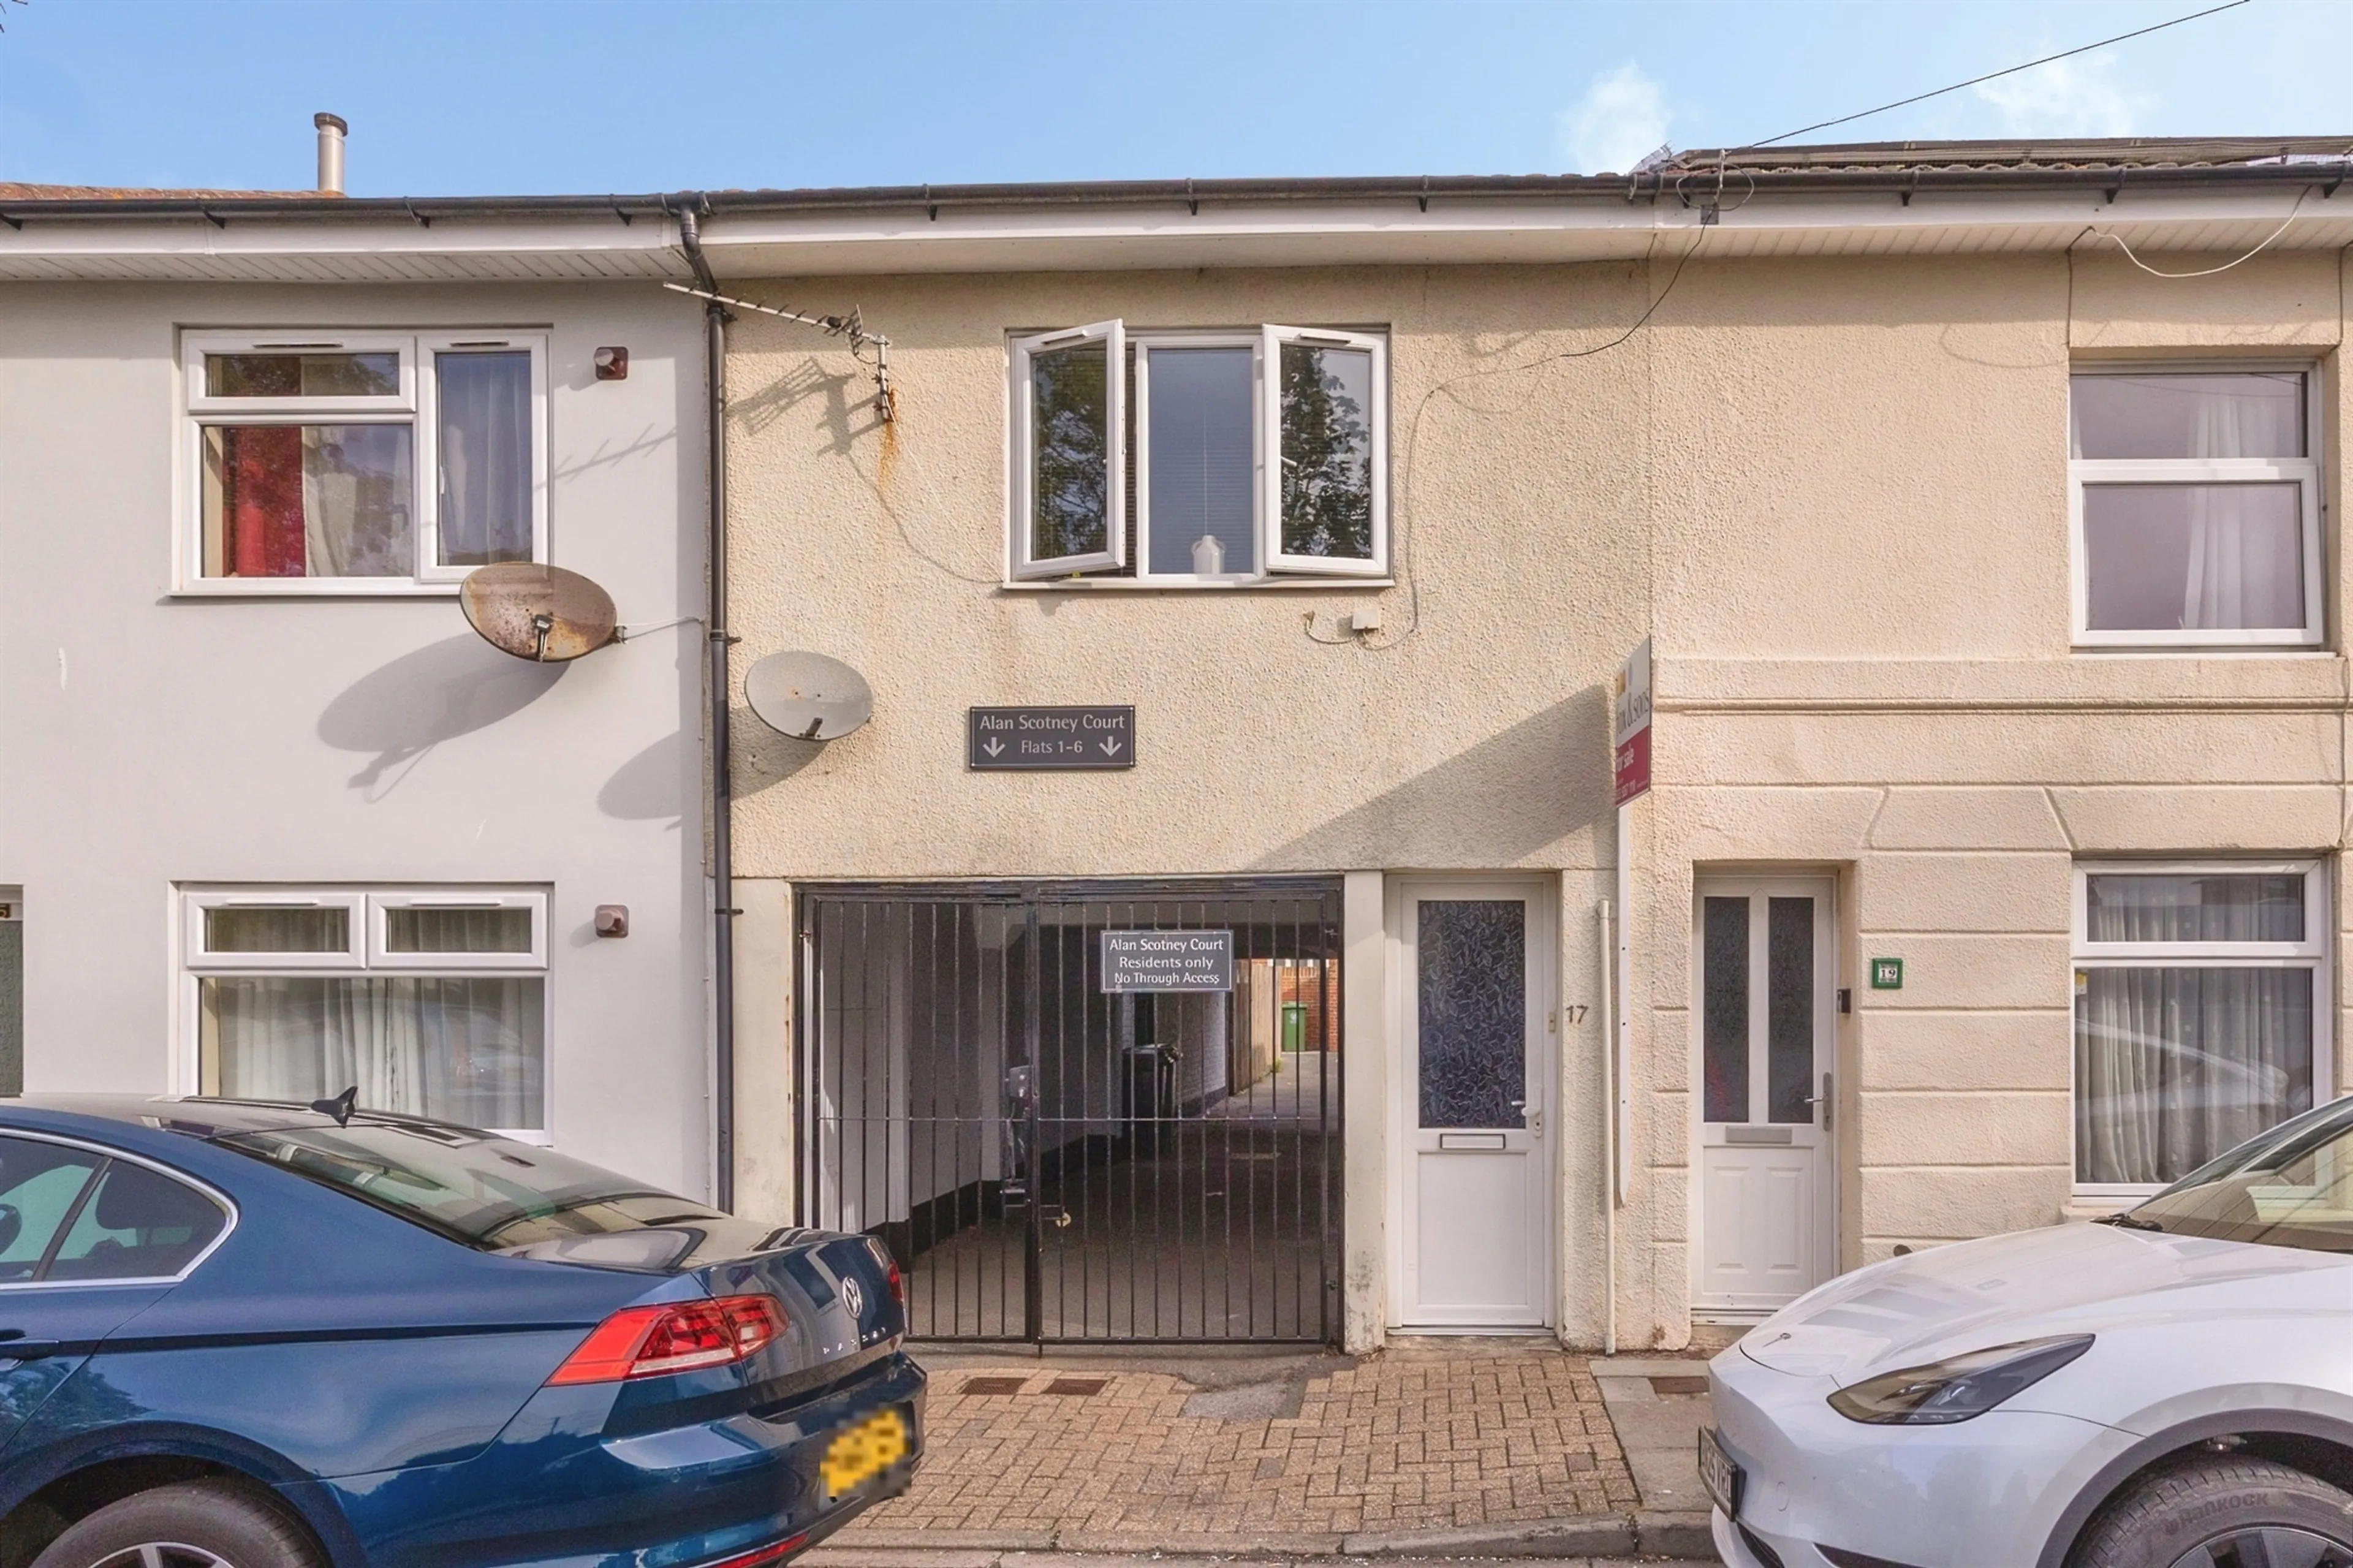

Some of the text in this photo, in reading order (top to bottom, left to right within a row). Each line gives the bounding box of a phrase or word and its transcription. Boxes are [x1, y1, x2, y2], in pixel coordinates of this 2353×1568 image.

[980, 714, 1125, 732] Alan Scotney Court
[1021, 740, 1083, 754] Flats 1-6
[1110, 938, 1224, 953] Alan Scotney Court
[1120, 956, 1214, 970] Residents only
[1114, 972, 1220, 986] No Through Access
[1881, 969, 1896, 978] 19
[1566, 1005, 1589, 1025] 17
